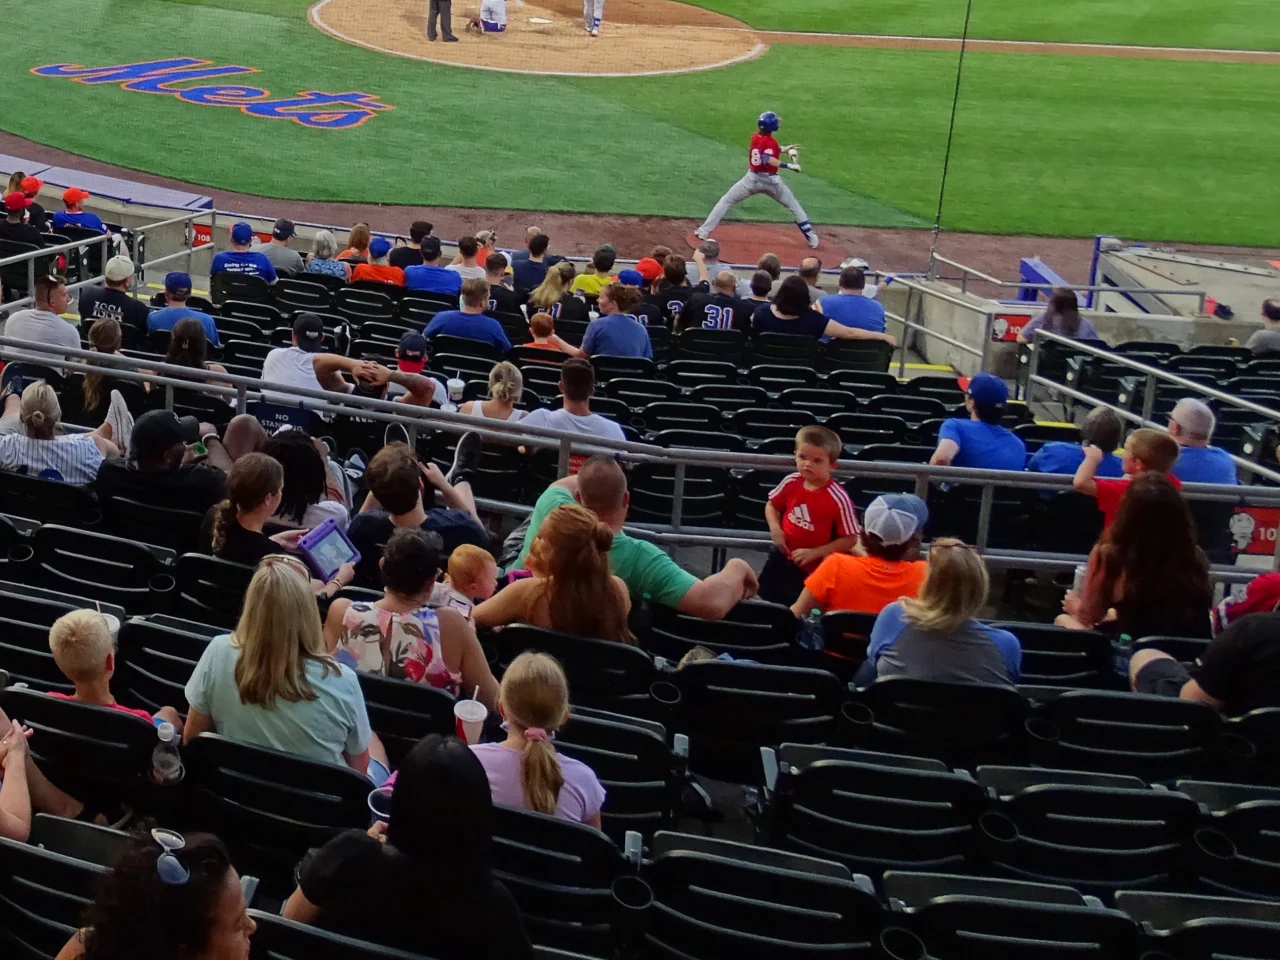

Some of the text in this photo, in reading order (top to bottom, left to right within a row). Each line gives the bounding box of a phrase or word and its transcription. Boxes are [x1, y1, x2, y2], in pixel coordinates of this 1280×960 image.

[29, 56, 398, 129] Mets
[702, 303, 734, 330] 31
[261, 420, 304, 433] STANNG
[275, 413, 289, 421] NO
[787, 512, 815, 531] adidas
